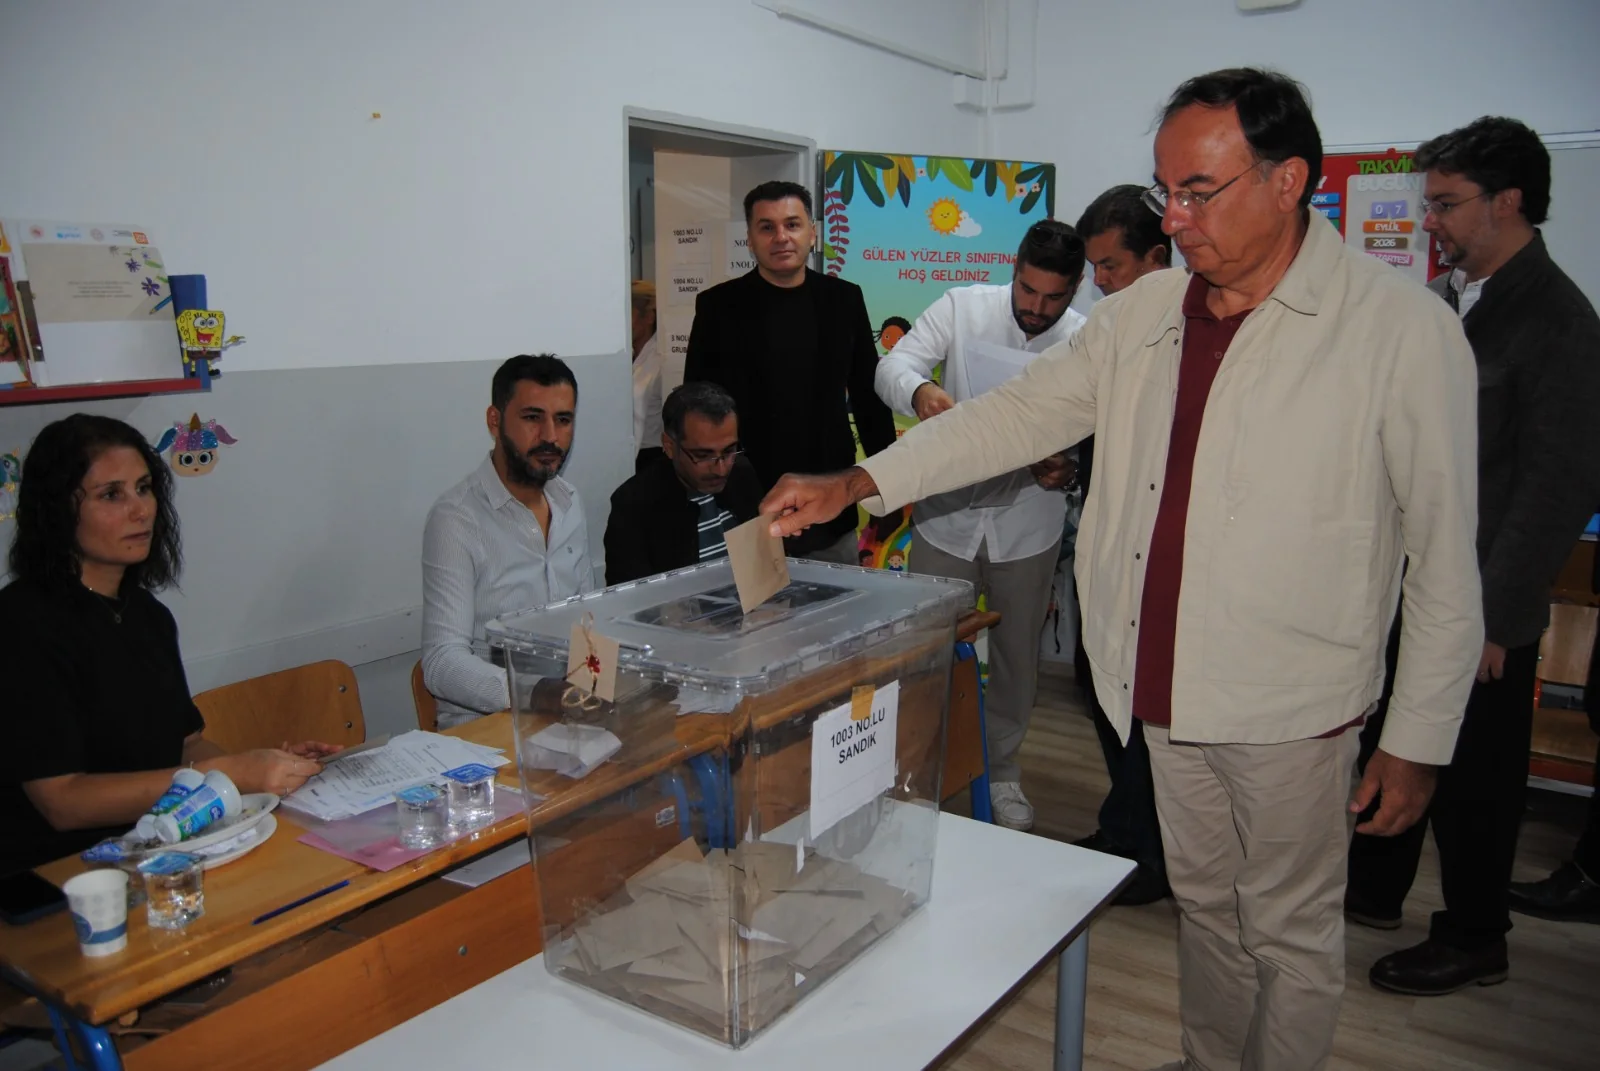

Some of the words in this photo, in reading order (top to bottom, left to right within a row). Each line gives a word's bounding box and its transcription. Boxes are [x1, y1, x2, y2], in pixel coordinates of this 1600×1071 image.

[1311, 195, 1327, 203] CAK
[1373, 239, 1396, 247] 2026
[863, 247, 905, 261] GÜLEN
[911, 248, 961, 263] YÜZLER
[899, 268, 926, 284] HOŞ
[931, 268, 990, 282] GELDİNİZ
[831, 725, 854, 748] 1003
[856, 707, 886, 735] NO.LU
[838, 731, 877, 764] SANDIK
